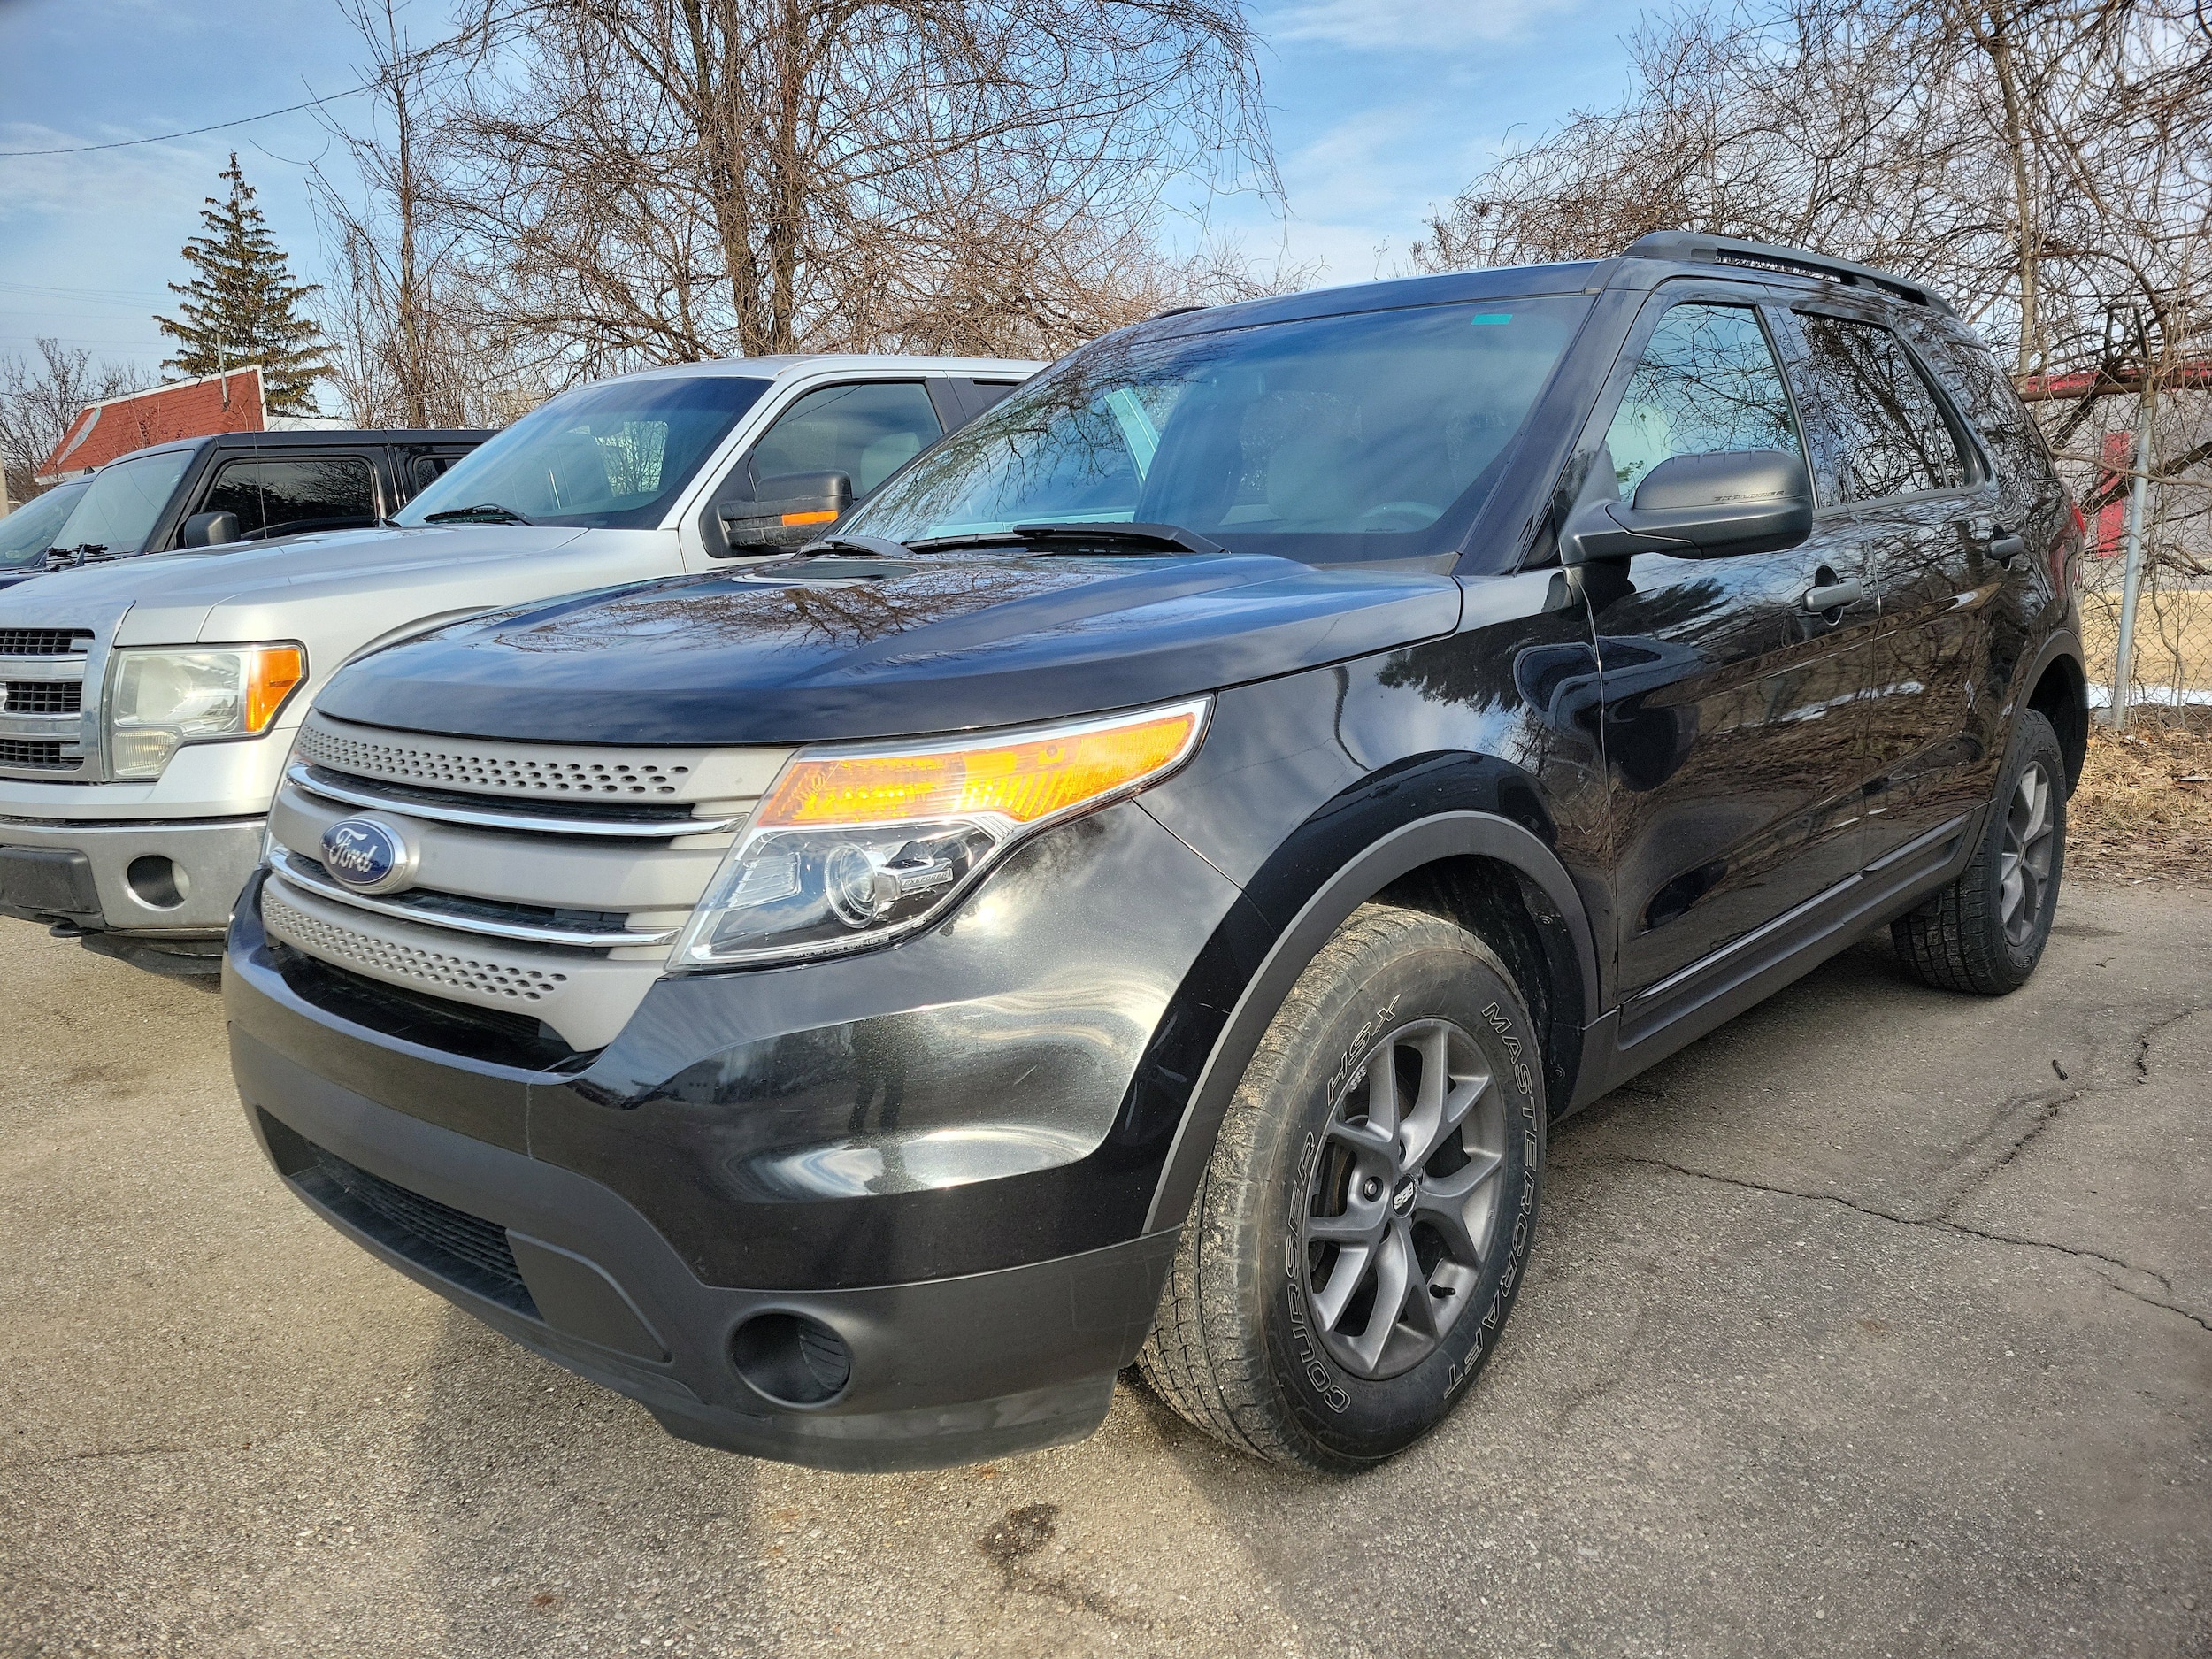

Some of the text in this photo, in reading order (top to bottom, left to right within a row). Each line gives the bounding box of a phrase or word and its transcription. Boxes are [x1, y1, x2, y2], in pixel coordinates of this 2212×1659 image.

[328, 827, 379, 873] Ford
[1286, 993, 1402, 1414] COURSER HSX
[1442, 1001, 1539, 1401] MASTERCRAFT
